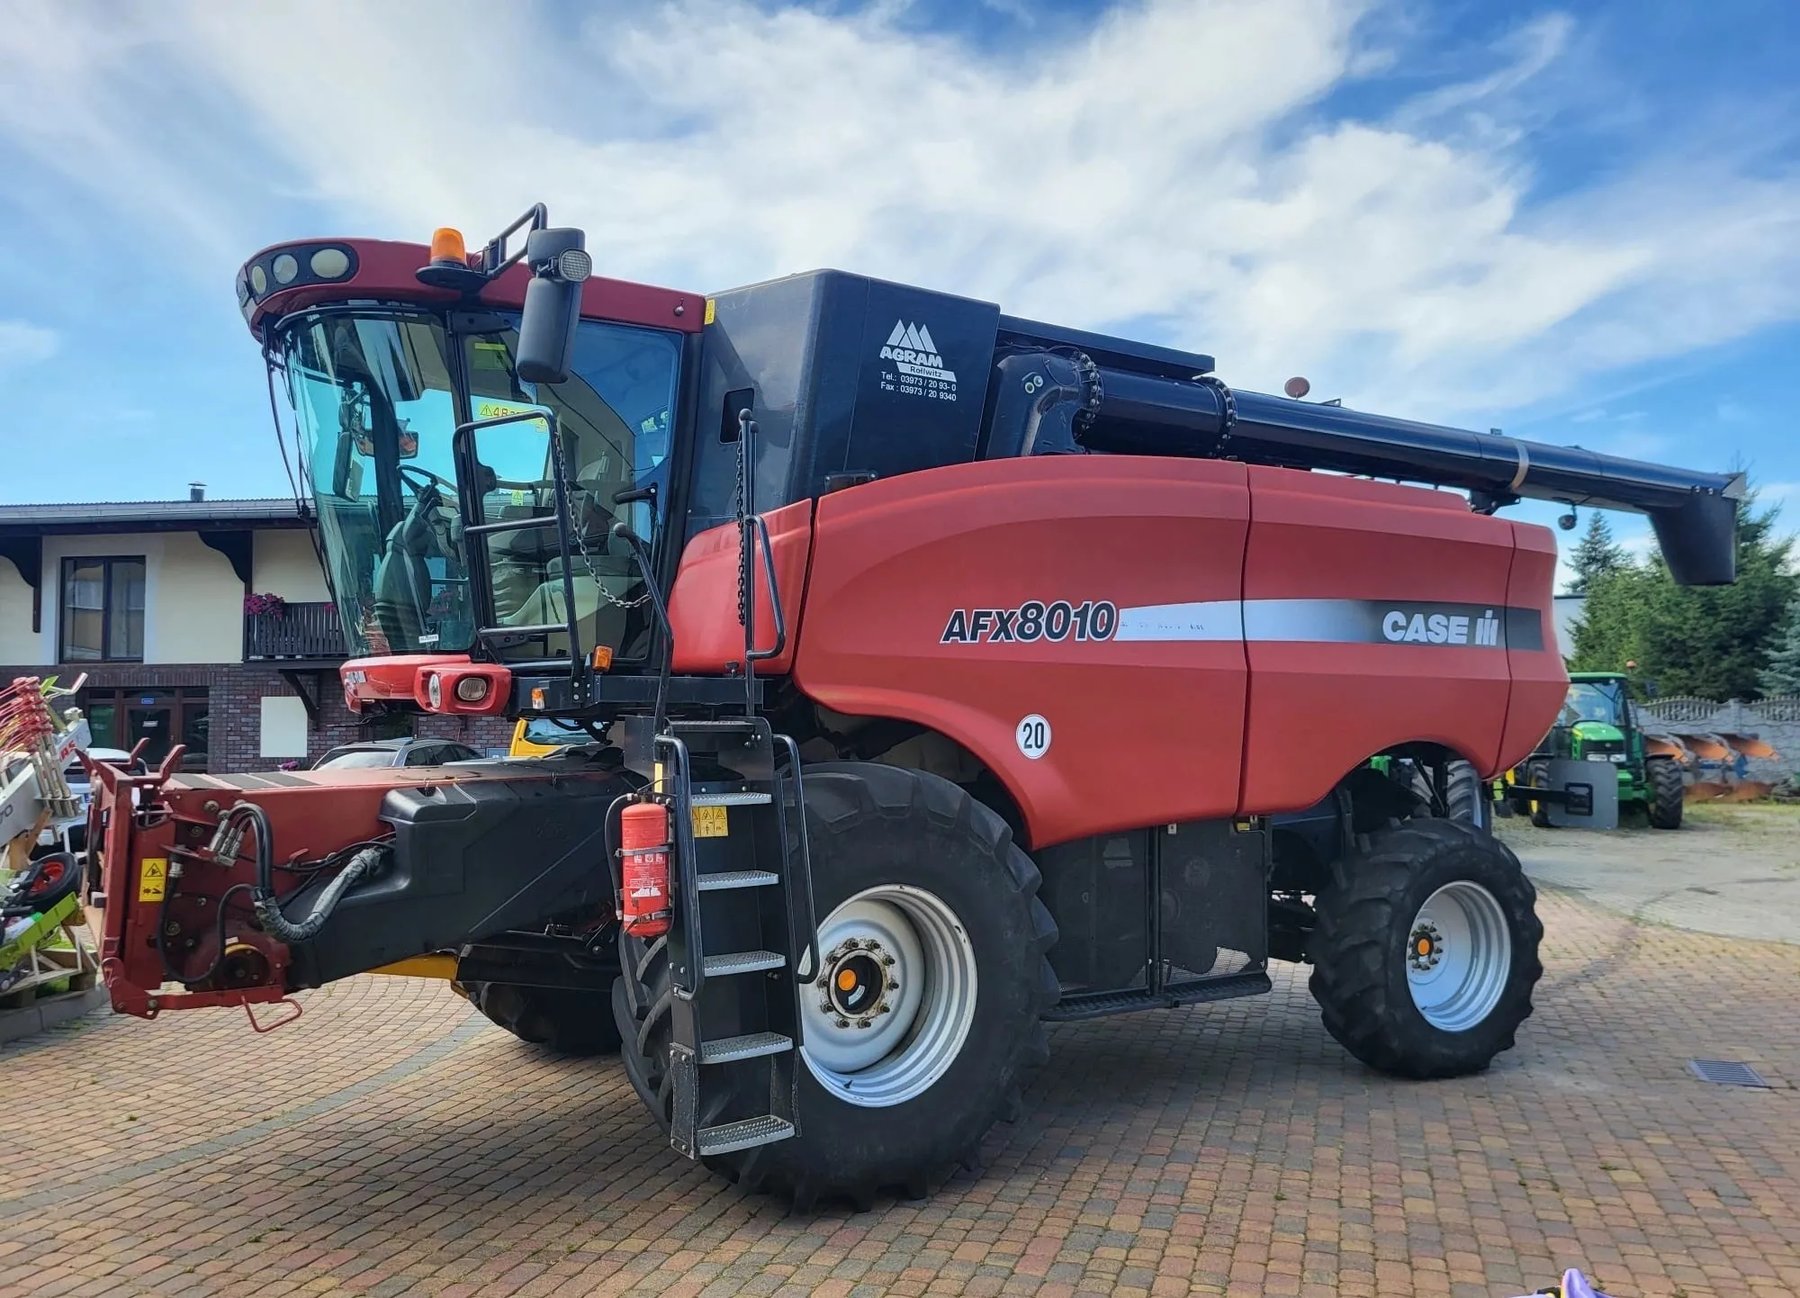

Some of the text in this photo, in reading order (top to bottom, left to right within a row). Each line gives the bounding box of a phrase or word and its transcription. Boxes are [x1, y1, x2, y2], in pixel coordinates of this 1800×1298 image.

[879, 346, 943, 368] AGRAM
[900, 375, 923, 386] 03973
[928, 379, 938, 389] 20
[910, 365, 943, 378] Rollwitz
[900, 384, 923, 396] 03973
[928, 389, 938, 399] 20
[939, 391, 957, 402] 9340
[939, 600, 1117, 644] AFX8010
[1382, 610, 1470, 644] CASE
[1022, 722, 1045, 749] 20
